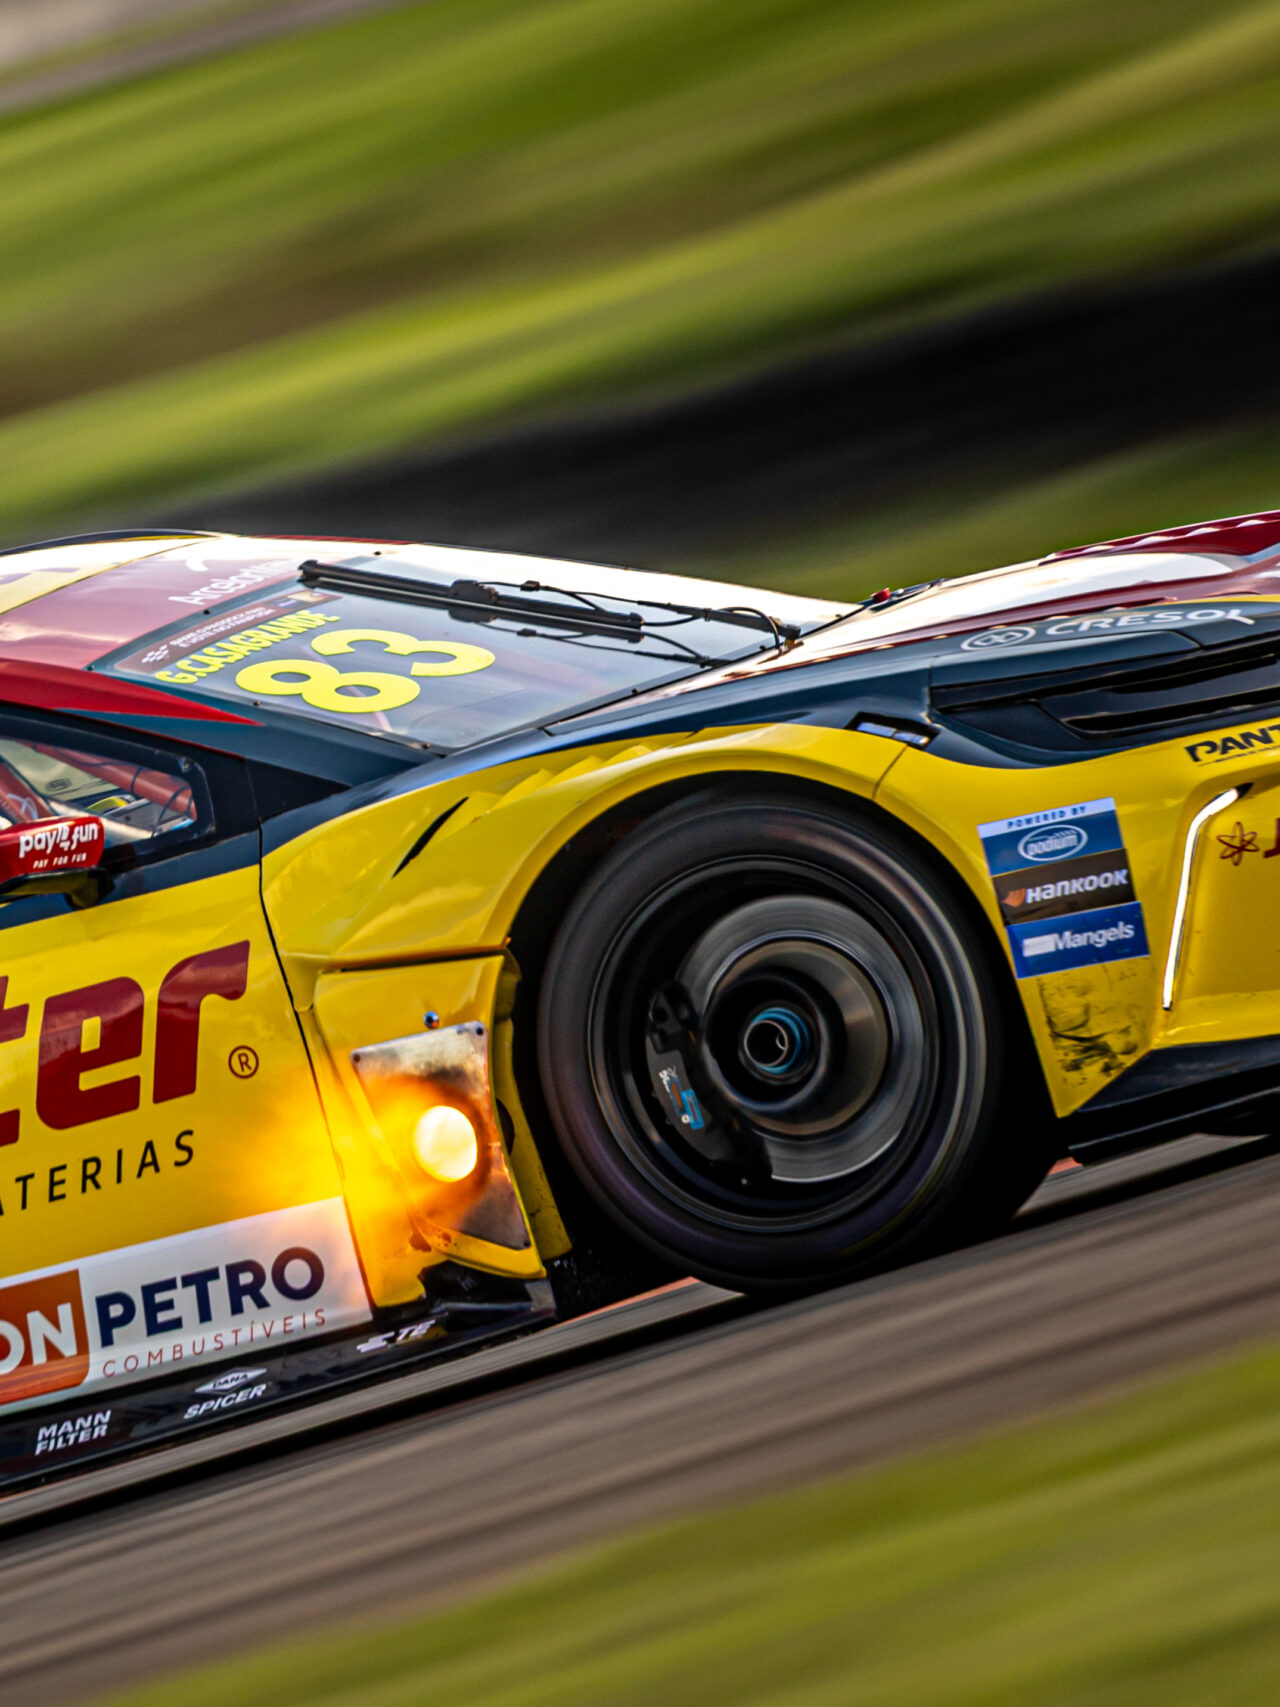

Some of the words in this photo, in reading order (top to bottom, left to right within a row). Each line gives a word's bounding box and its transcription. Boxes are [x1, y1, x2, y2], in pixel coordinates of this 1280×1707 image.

[1045, 608, 1256, 635] CRESOL
[154, 609, 342, 684] G.CASAGRANDE
[235, 628, 496, 713] 83
[1007, 810, 1066, 829] POWERED
[1072, 805, 1087, 815] BY
[33, 858, 49, 869] PAY
[1054, 921, 1135, 951] Mangels
[95, 1246, 325, 1348] PETRO
[102, 1308, 327, 1378] COMBUSTÍVEIS
[183, 1383, 267, 1419] SPICER
[34, 1424, 108, 1456] FILTER
[37, 1409, 111, 1441] MANN
